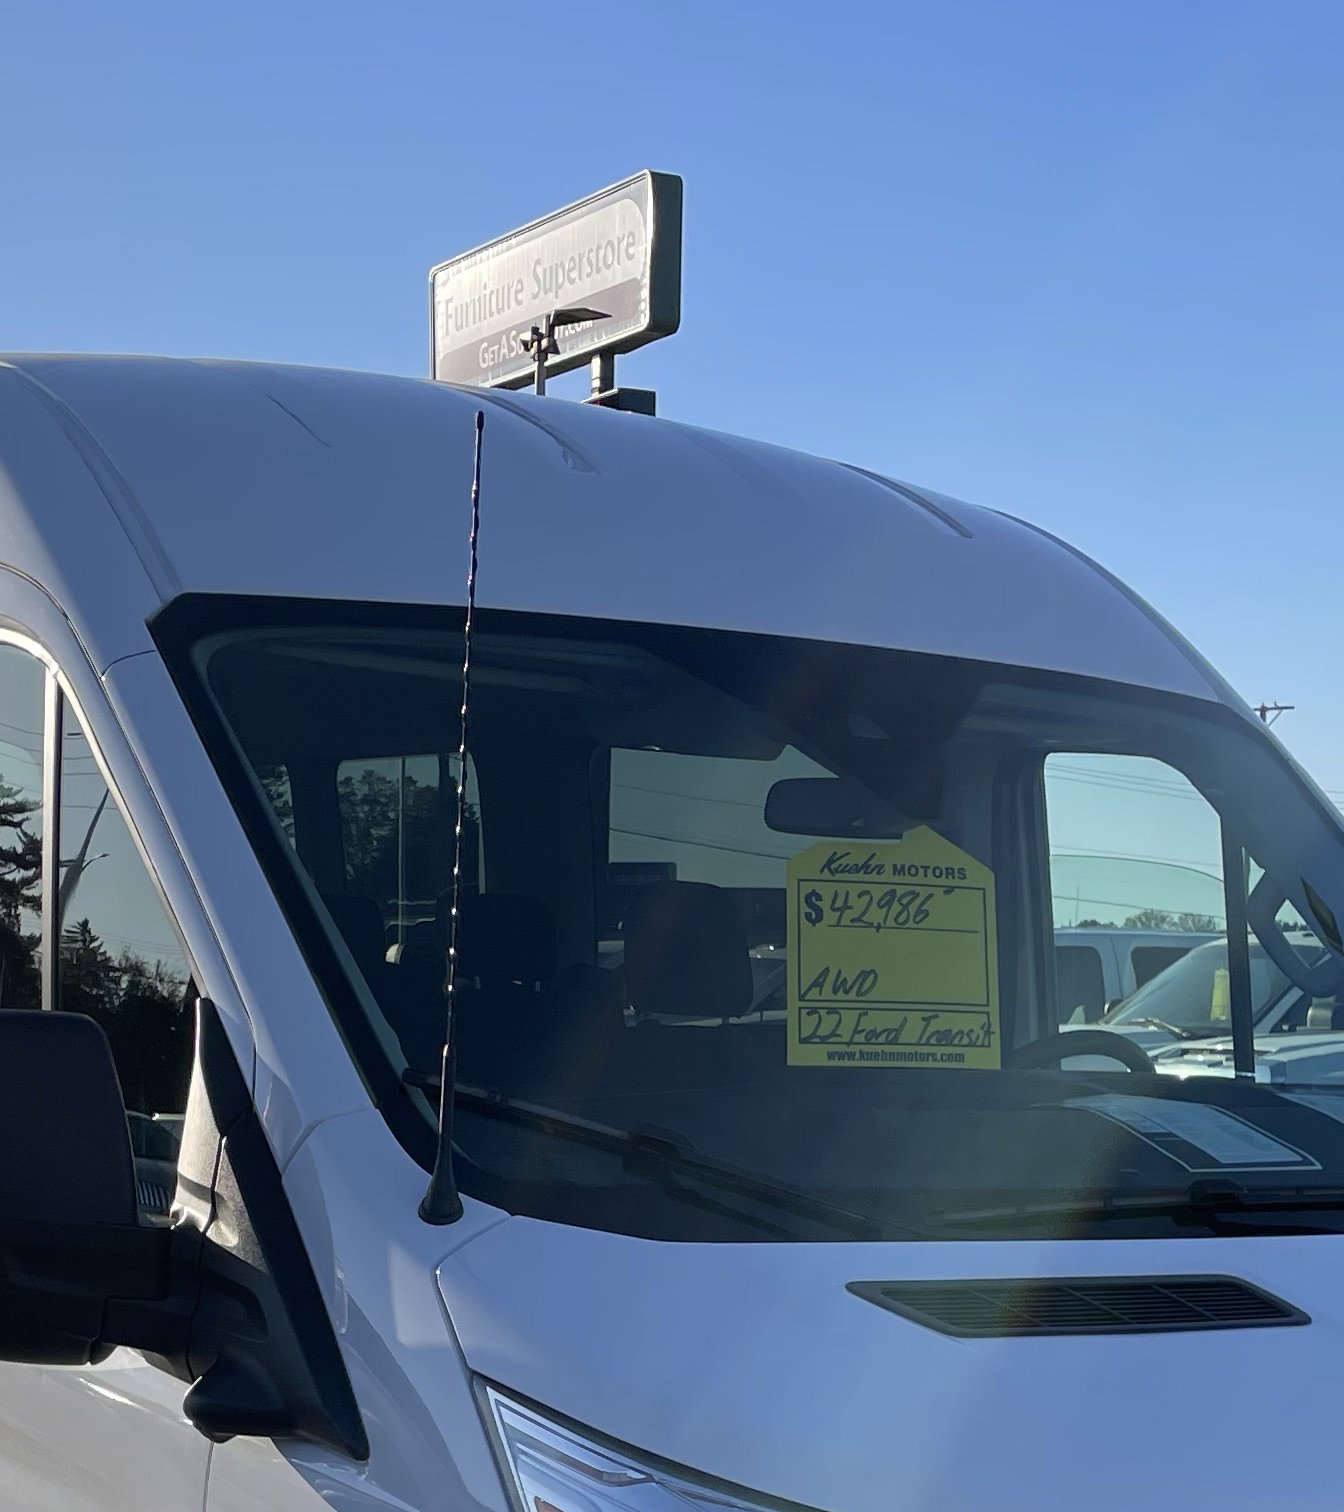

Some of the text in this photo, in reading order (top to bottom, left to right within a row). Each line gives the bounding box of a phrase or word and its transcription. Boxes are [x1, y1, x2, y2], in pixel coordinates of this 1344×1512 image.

[443, 229, 636, 337] Furniture Superstore
[819, 851, 967, 881] Kuehn MOTORS
[800, 966, 879, 1000] AWD
[845, 1010, 909, 1047] Ford
[914, 1013, 994, 1047] Transit
[826, 1050, 966, 1064] www.kuehnmotors.com
